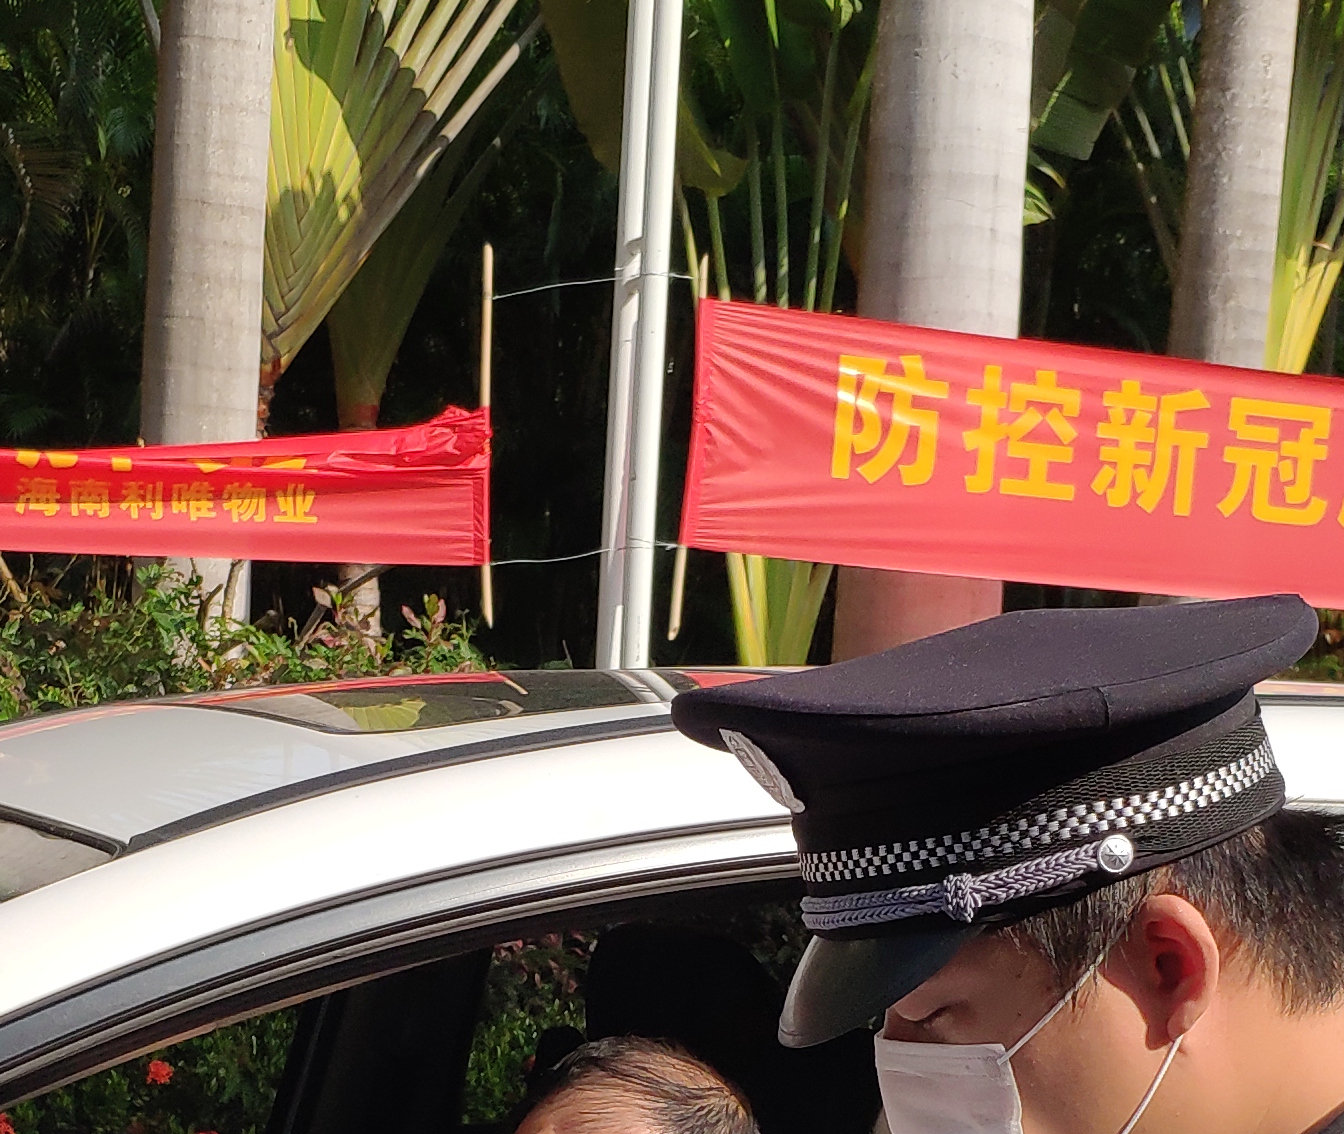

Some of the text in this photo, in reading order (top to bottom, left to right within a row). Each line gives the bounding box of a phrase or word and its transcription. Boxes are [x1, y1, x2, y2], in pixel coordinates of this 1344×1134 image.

[15, 476, 319, 525] 海南利唯物业
